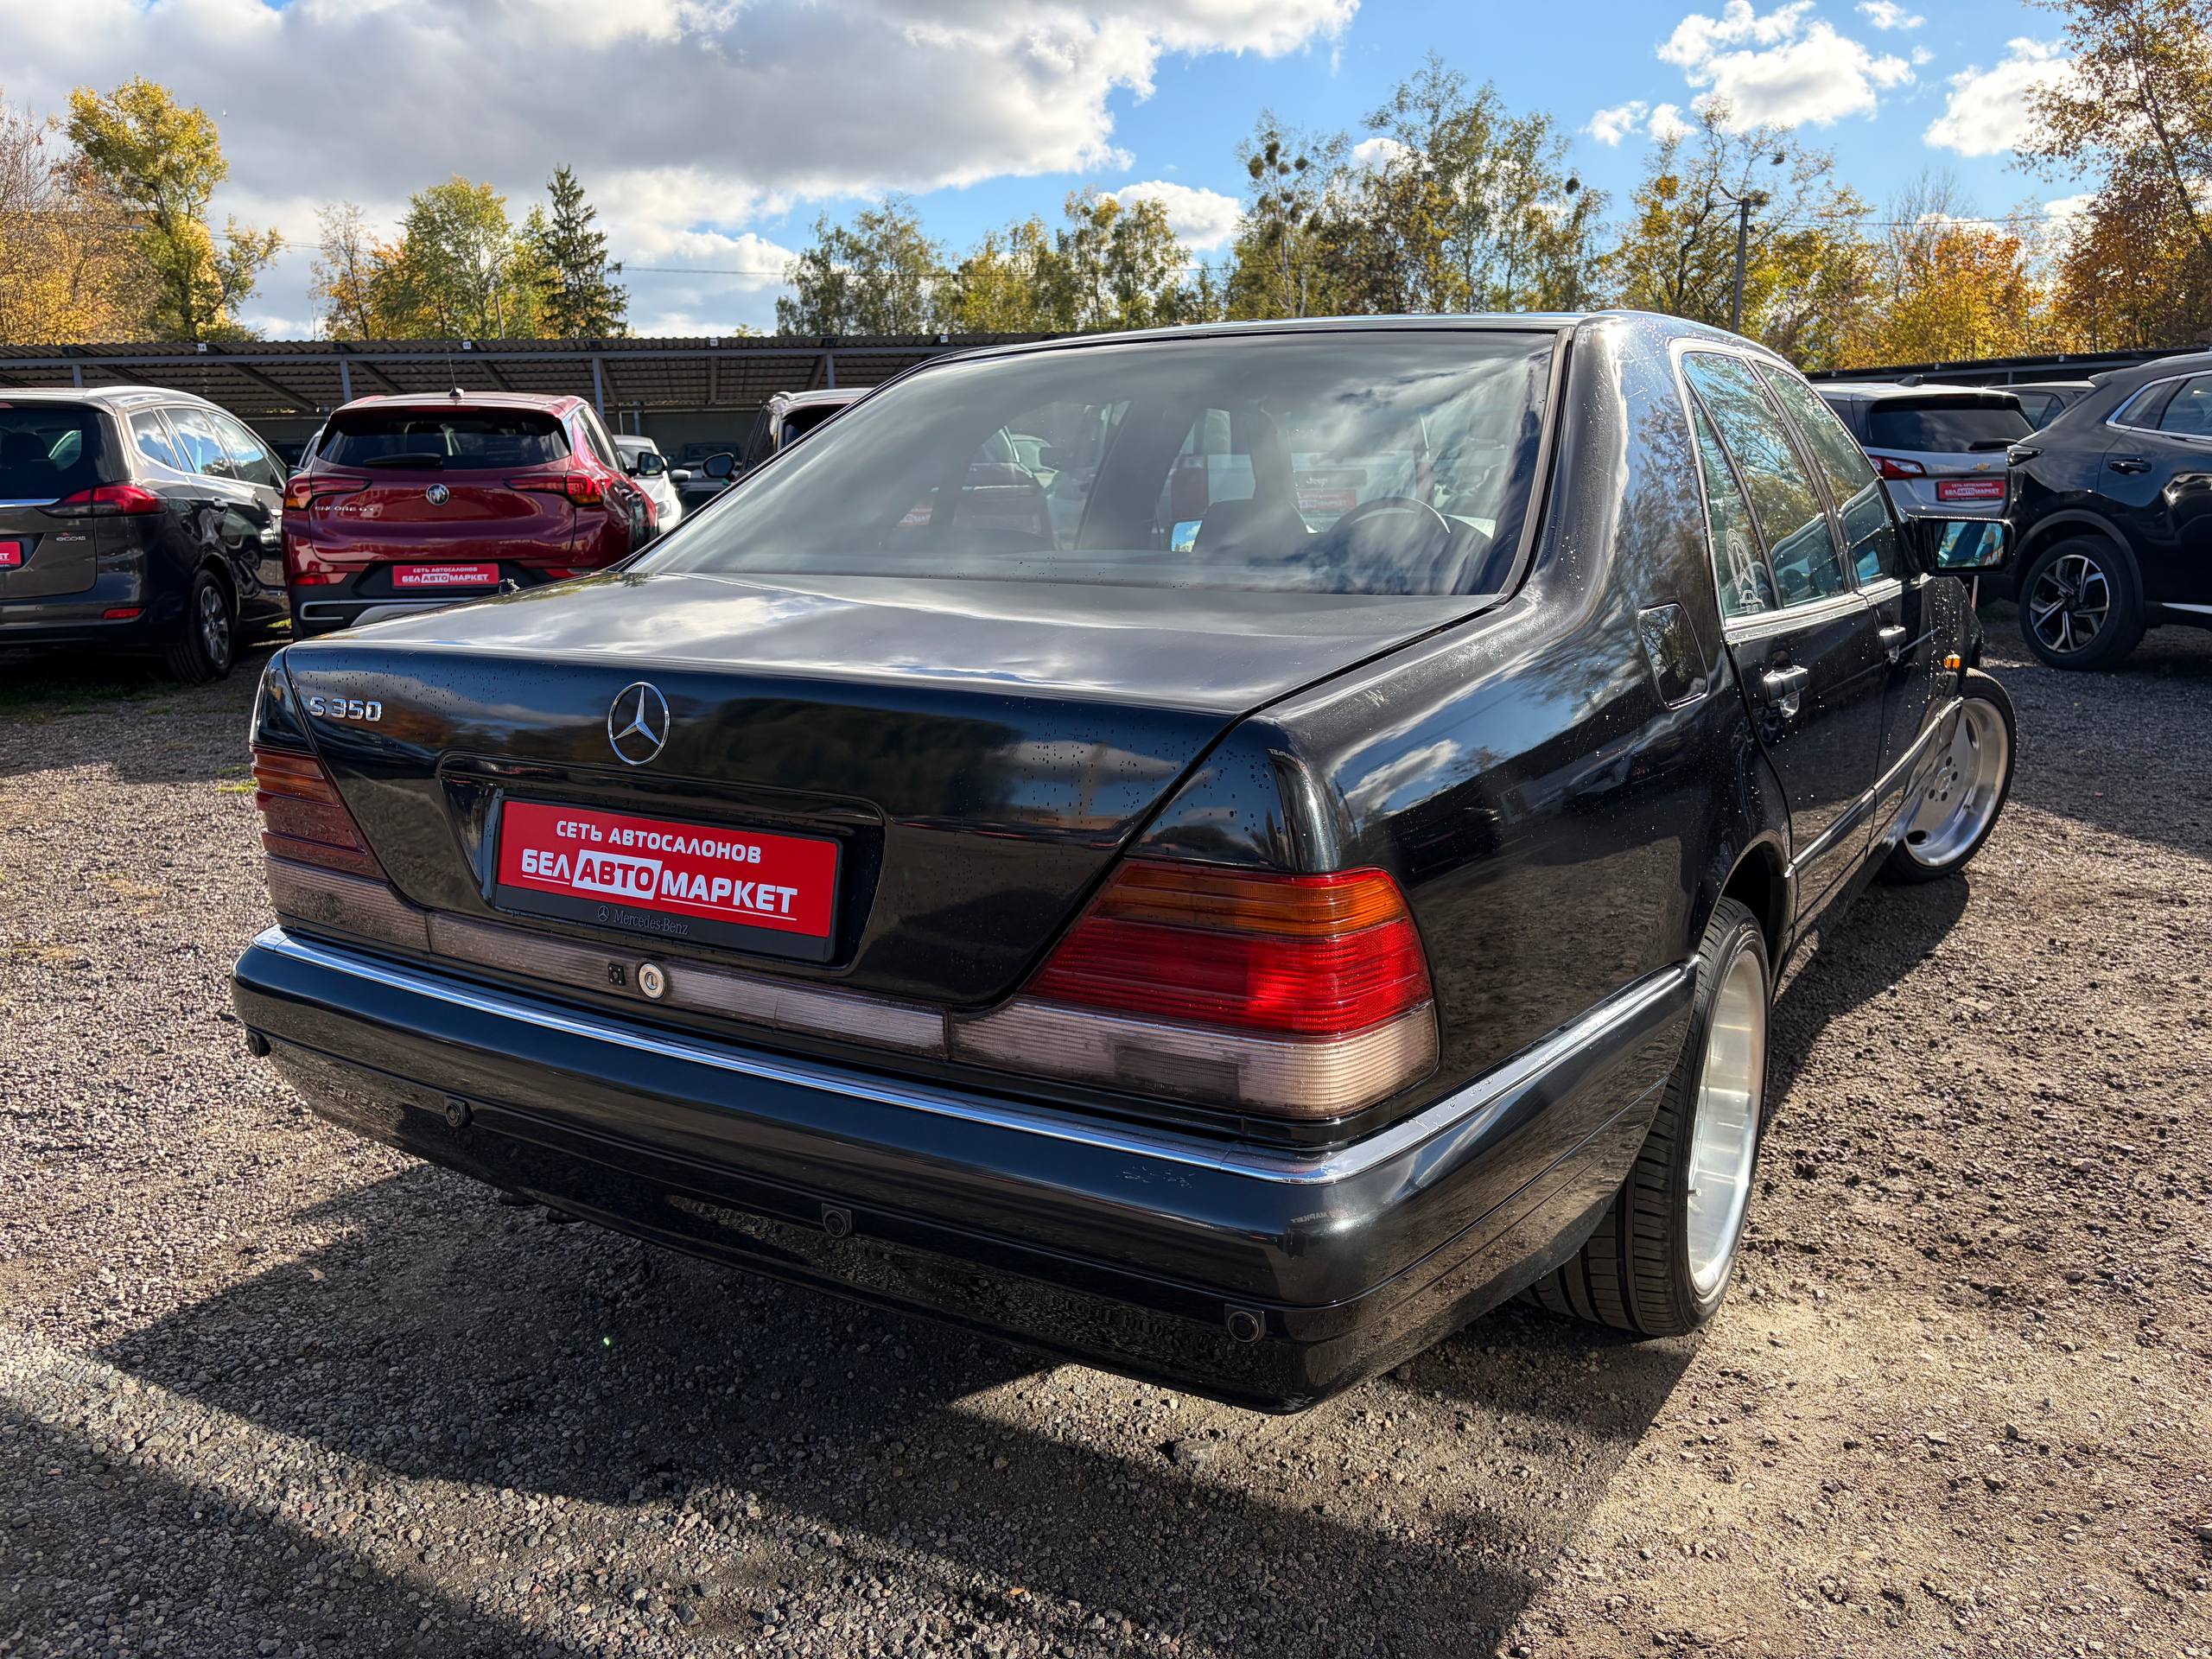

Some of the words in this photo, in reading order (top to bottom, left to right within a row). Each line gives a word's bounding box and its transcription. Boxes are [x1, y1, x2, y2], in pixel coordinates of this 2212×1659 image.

[309, 696, 327, 717] S
[331, 697, 383, 722] 350
[556, 820, 602, 842] СЕТЬ
[608, 827, 762, 864] АВТОСАЛОНОВ
[613, 910, 690, 936] Mercedes-Benz
